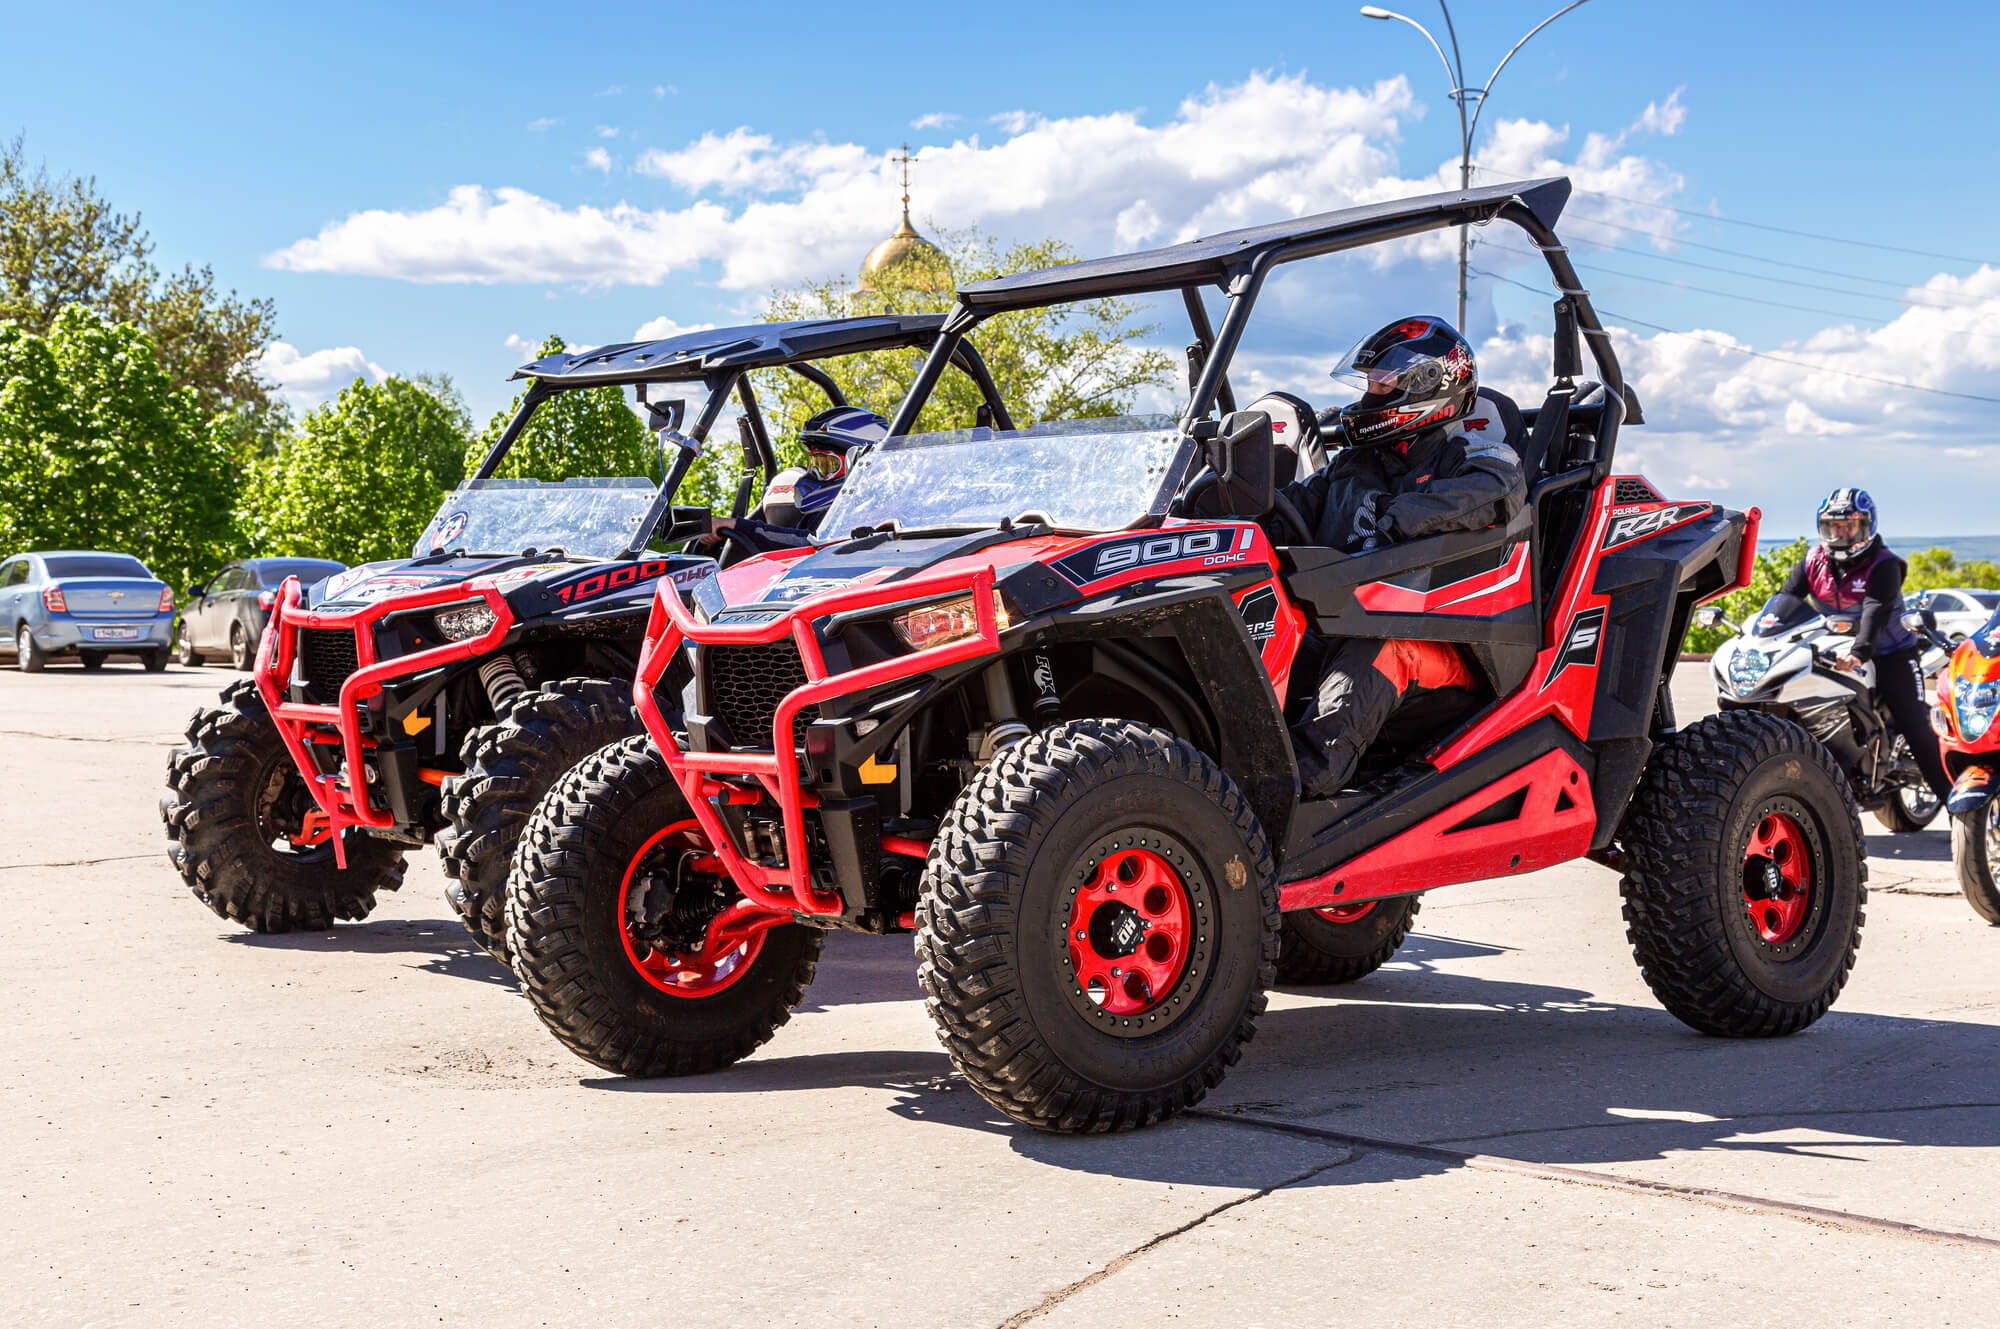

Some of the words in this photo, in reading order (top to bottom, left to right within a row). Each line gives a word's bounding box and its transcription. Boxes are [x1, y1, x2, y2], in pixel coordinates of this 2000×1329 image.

[1608, 505, 1680, 545] RZR
[1095, 531, 1219, 574] 900
[1203, 552, 1246, 566] DOHC
[556, 560, 667, 604] 1000
[671, 564, 716, 585] OHC
[1246, 620, 1275, 634] EPS
